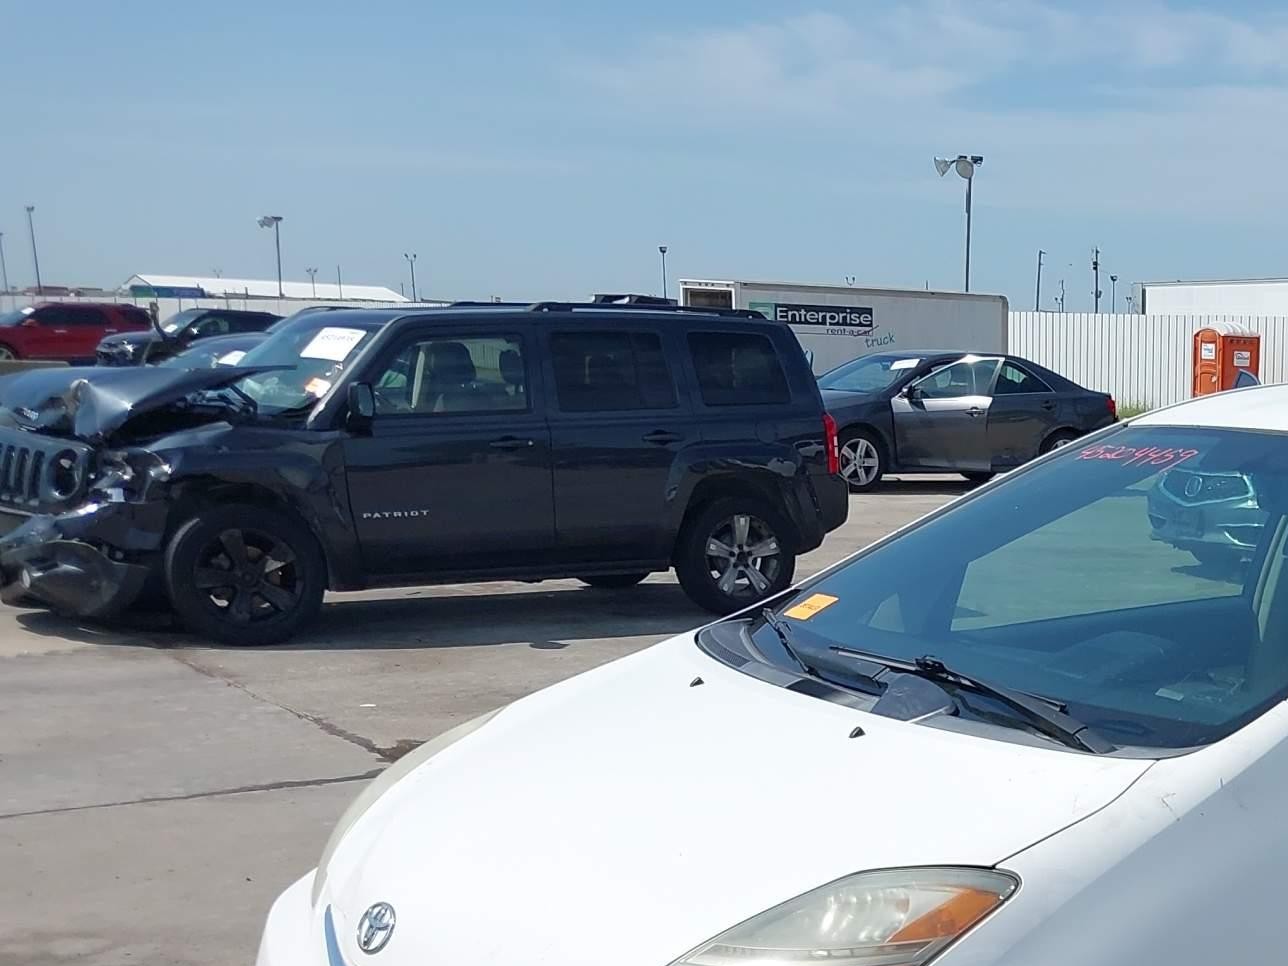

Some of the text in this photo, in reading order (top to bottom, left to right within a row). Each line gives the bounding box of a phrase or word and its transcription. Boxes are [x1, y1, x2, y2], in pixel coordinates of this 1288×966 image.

[776, 307, 873, 326] Enterprise
[865, 332, 896, 348] truck
[362, 509, 430, 519] PATRIOT
